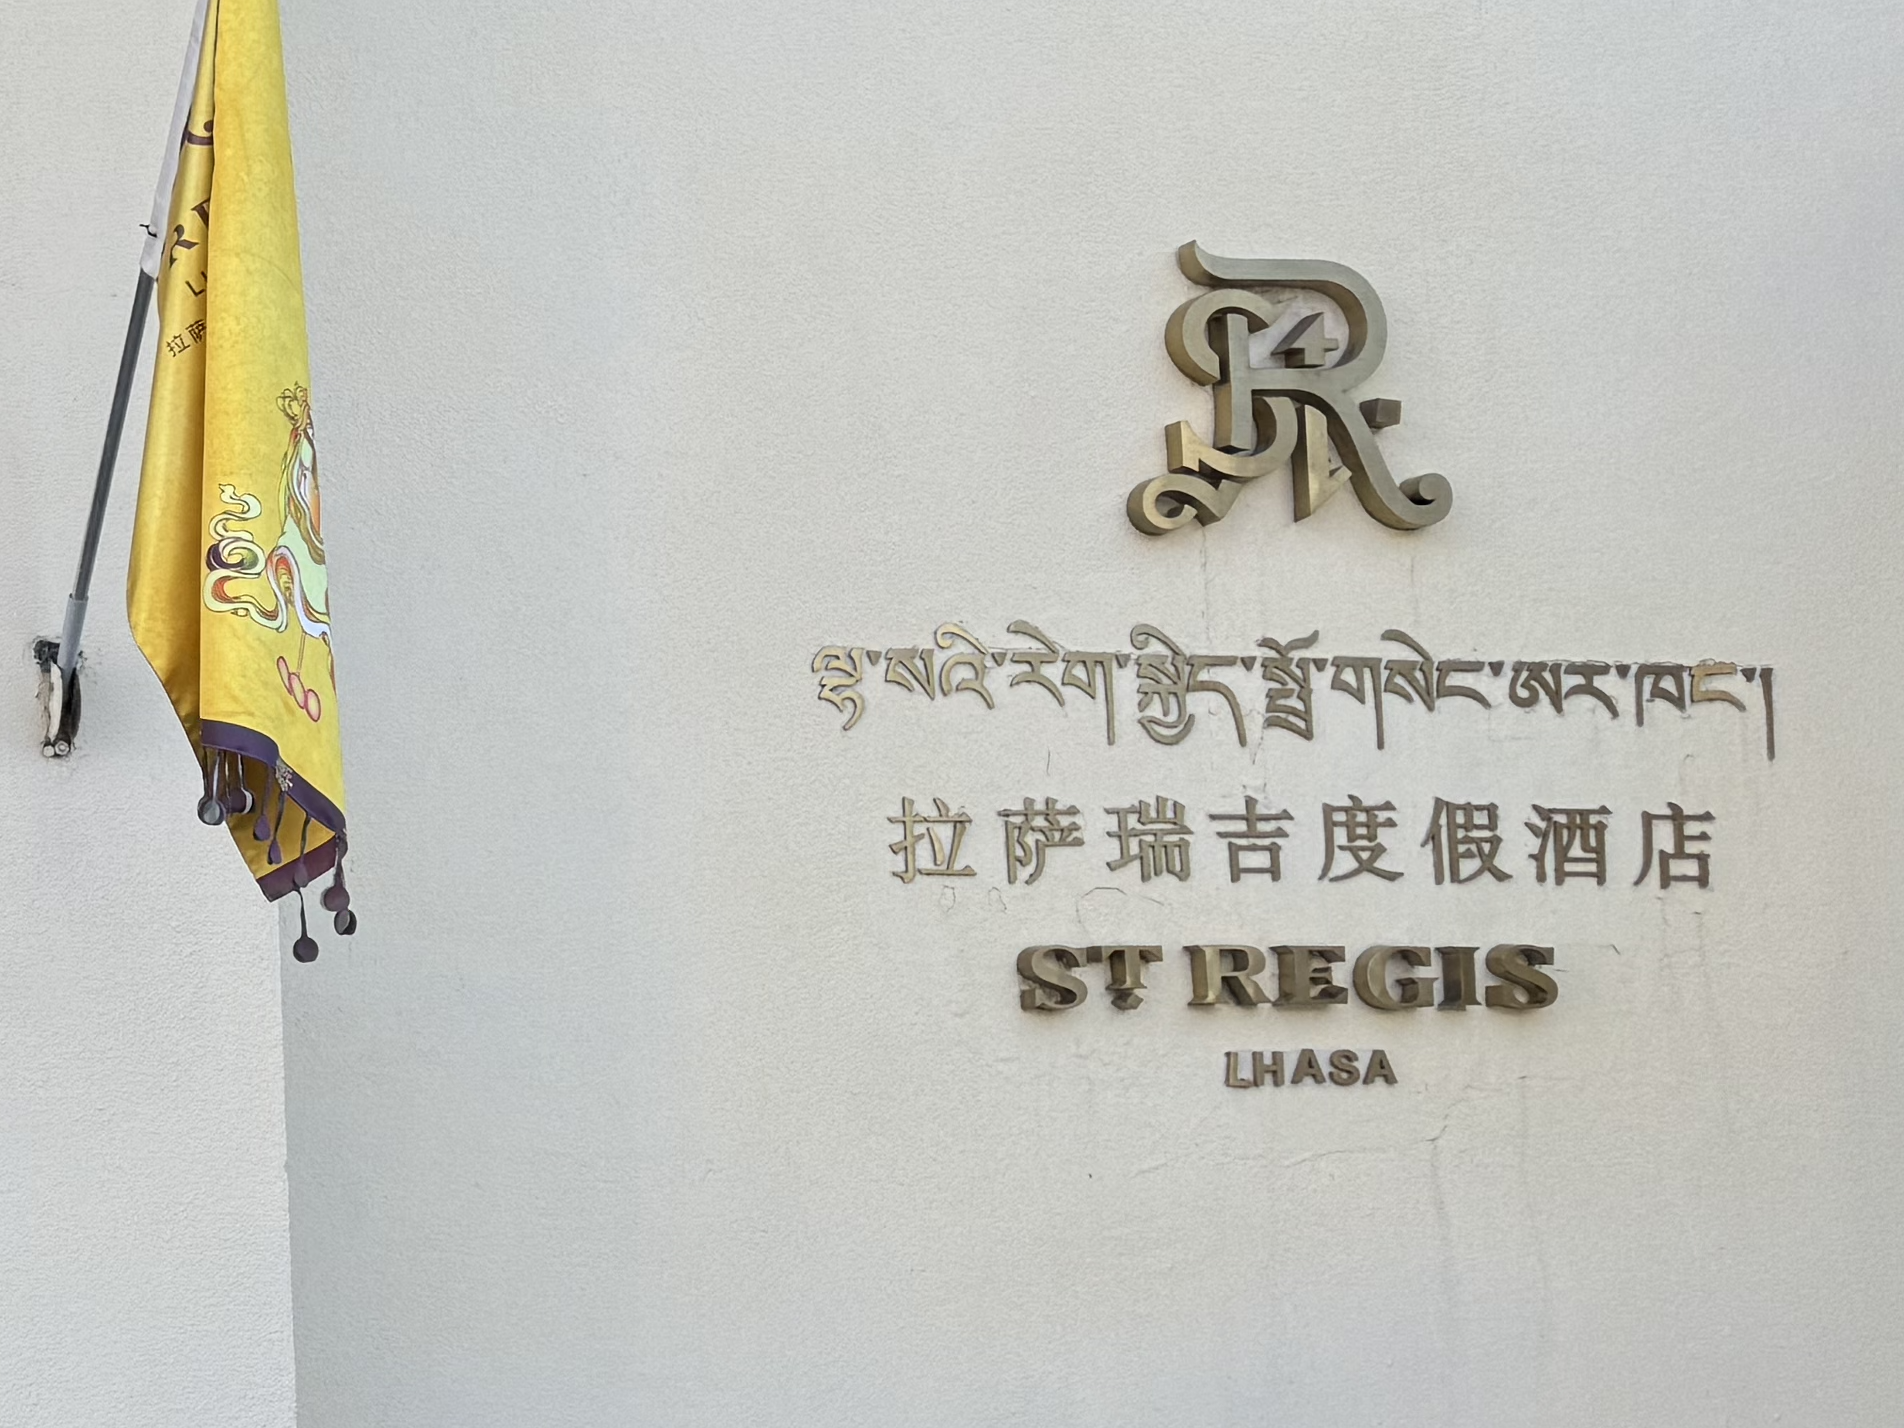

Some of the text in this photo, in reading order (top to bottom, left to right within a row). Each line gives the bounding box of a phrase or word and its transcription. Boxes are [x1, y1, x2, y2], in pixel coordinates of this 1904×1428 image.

[887, 794, 1716, 889] 拉萨瑞吉度假酒店
[1182, 943, 1559, 1011] REGIS
[1224, 1048, 1398, 1088] LHASA
